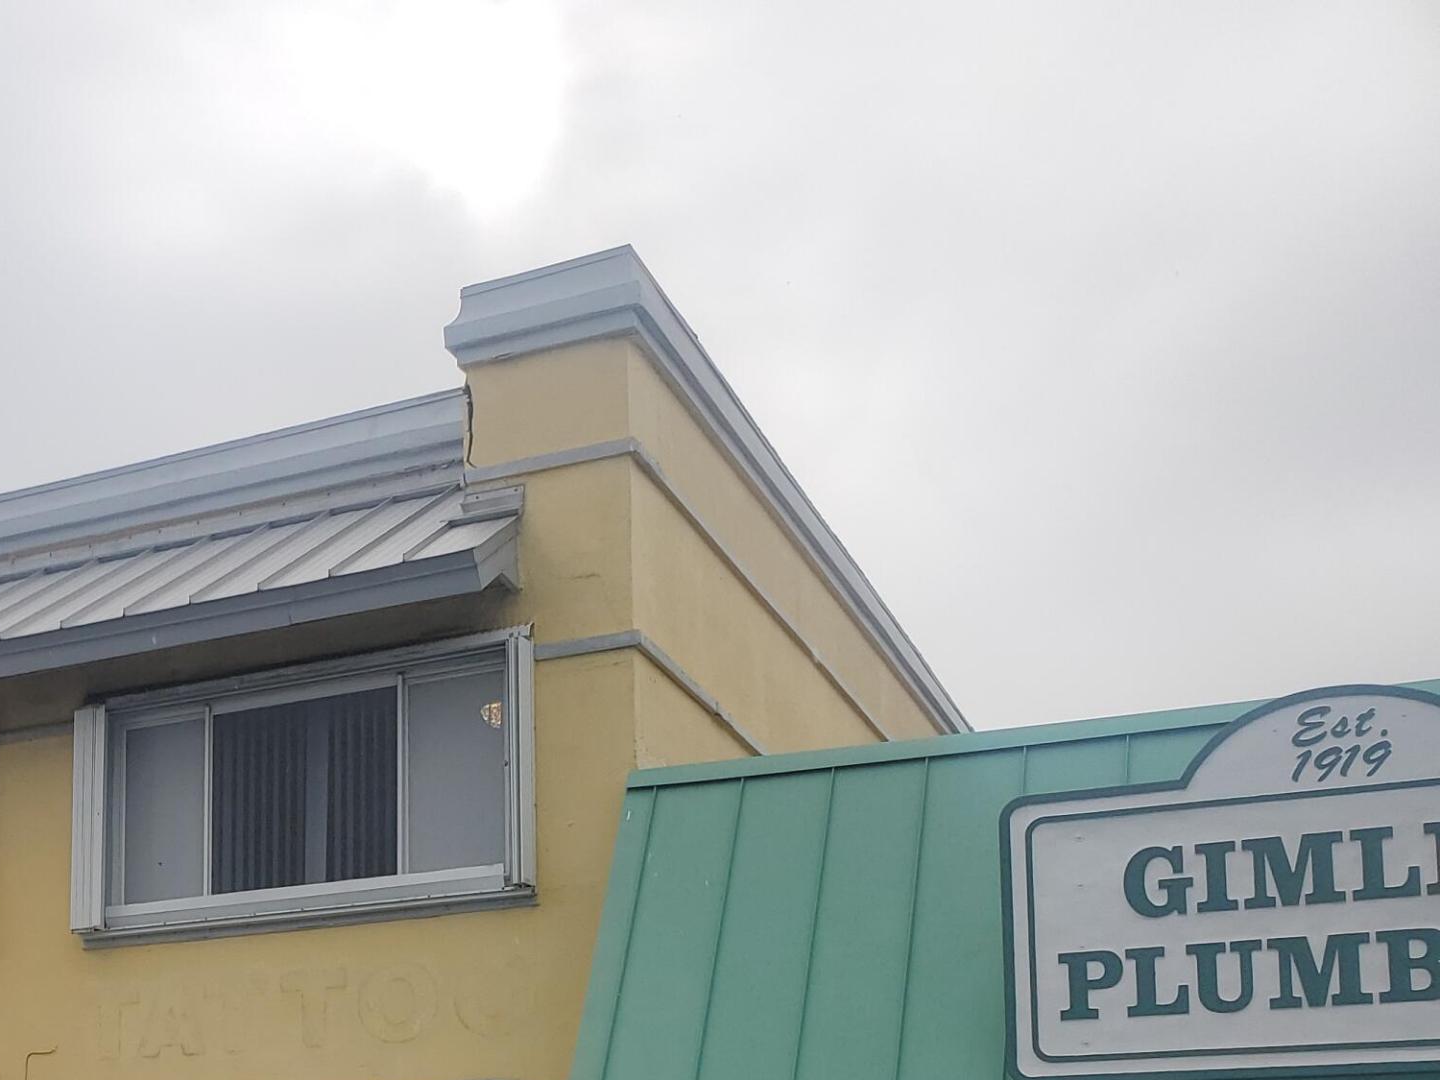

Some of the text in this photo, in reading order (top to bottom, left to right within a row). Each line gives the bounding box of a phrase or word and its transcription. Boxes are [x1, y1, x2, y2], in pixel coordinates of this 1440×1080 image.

[1291, 705, 1389, 748] Est.
[1292, 740, 1392, 783] 1919
[1058, 928, 1440, 1021] PLUMB
